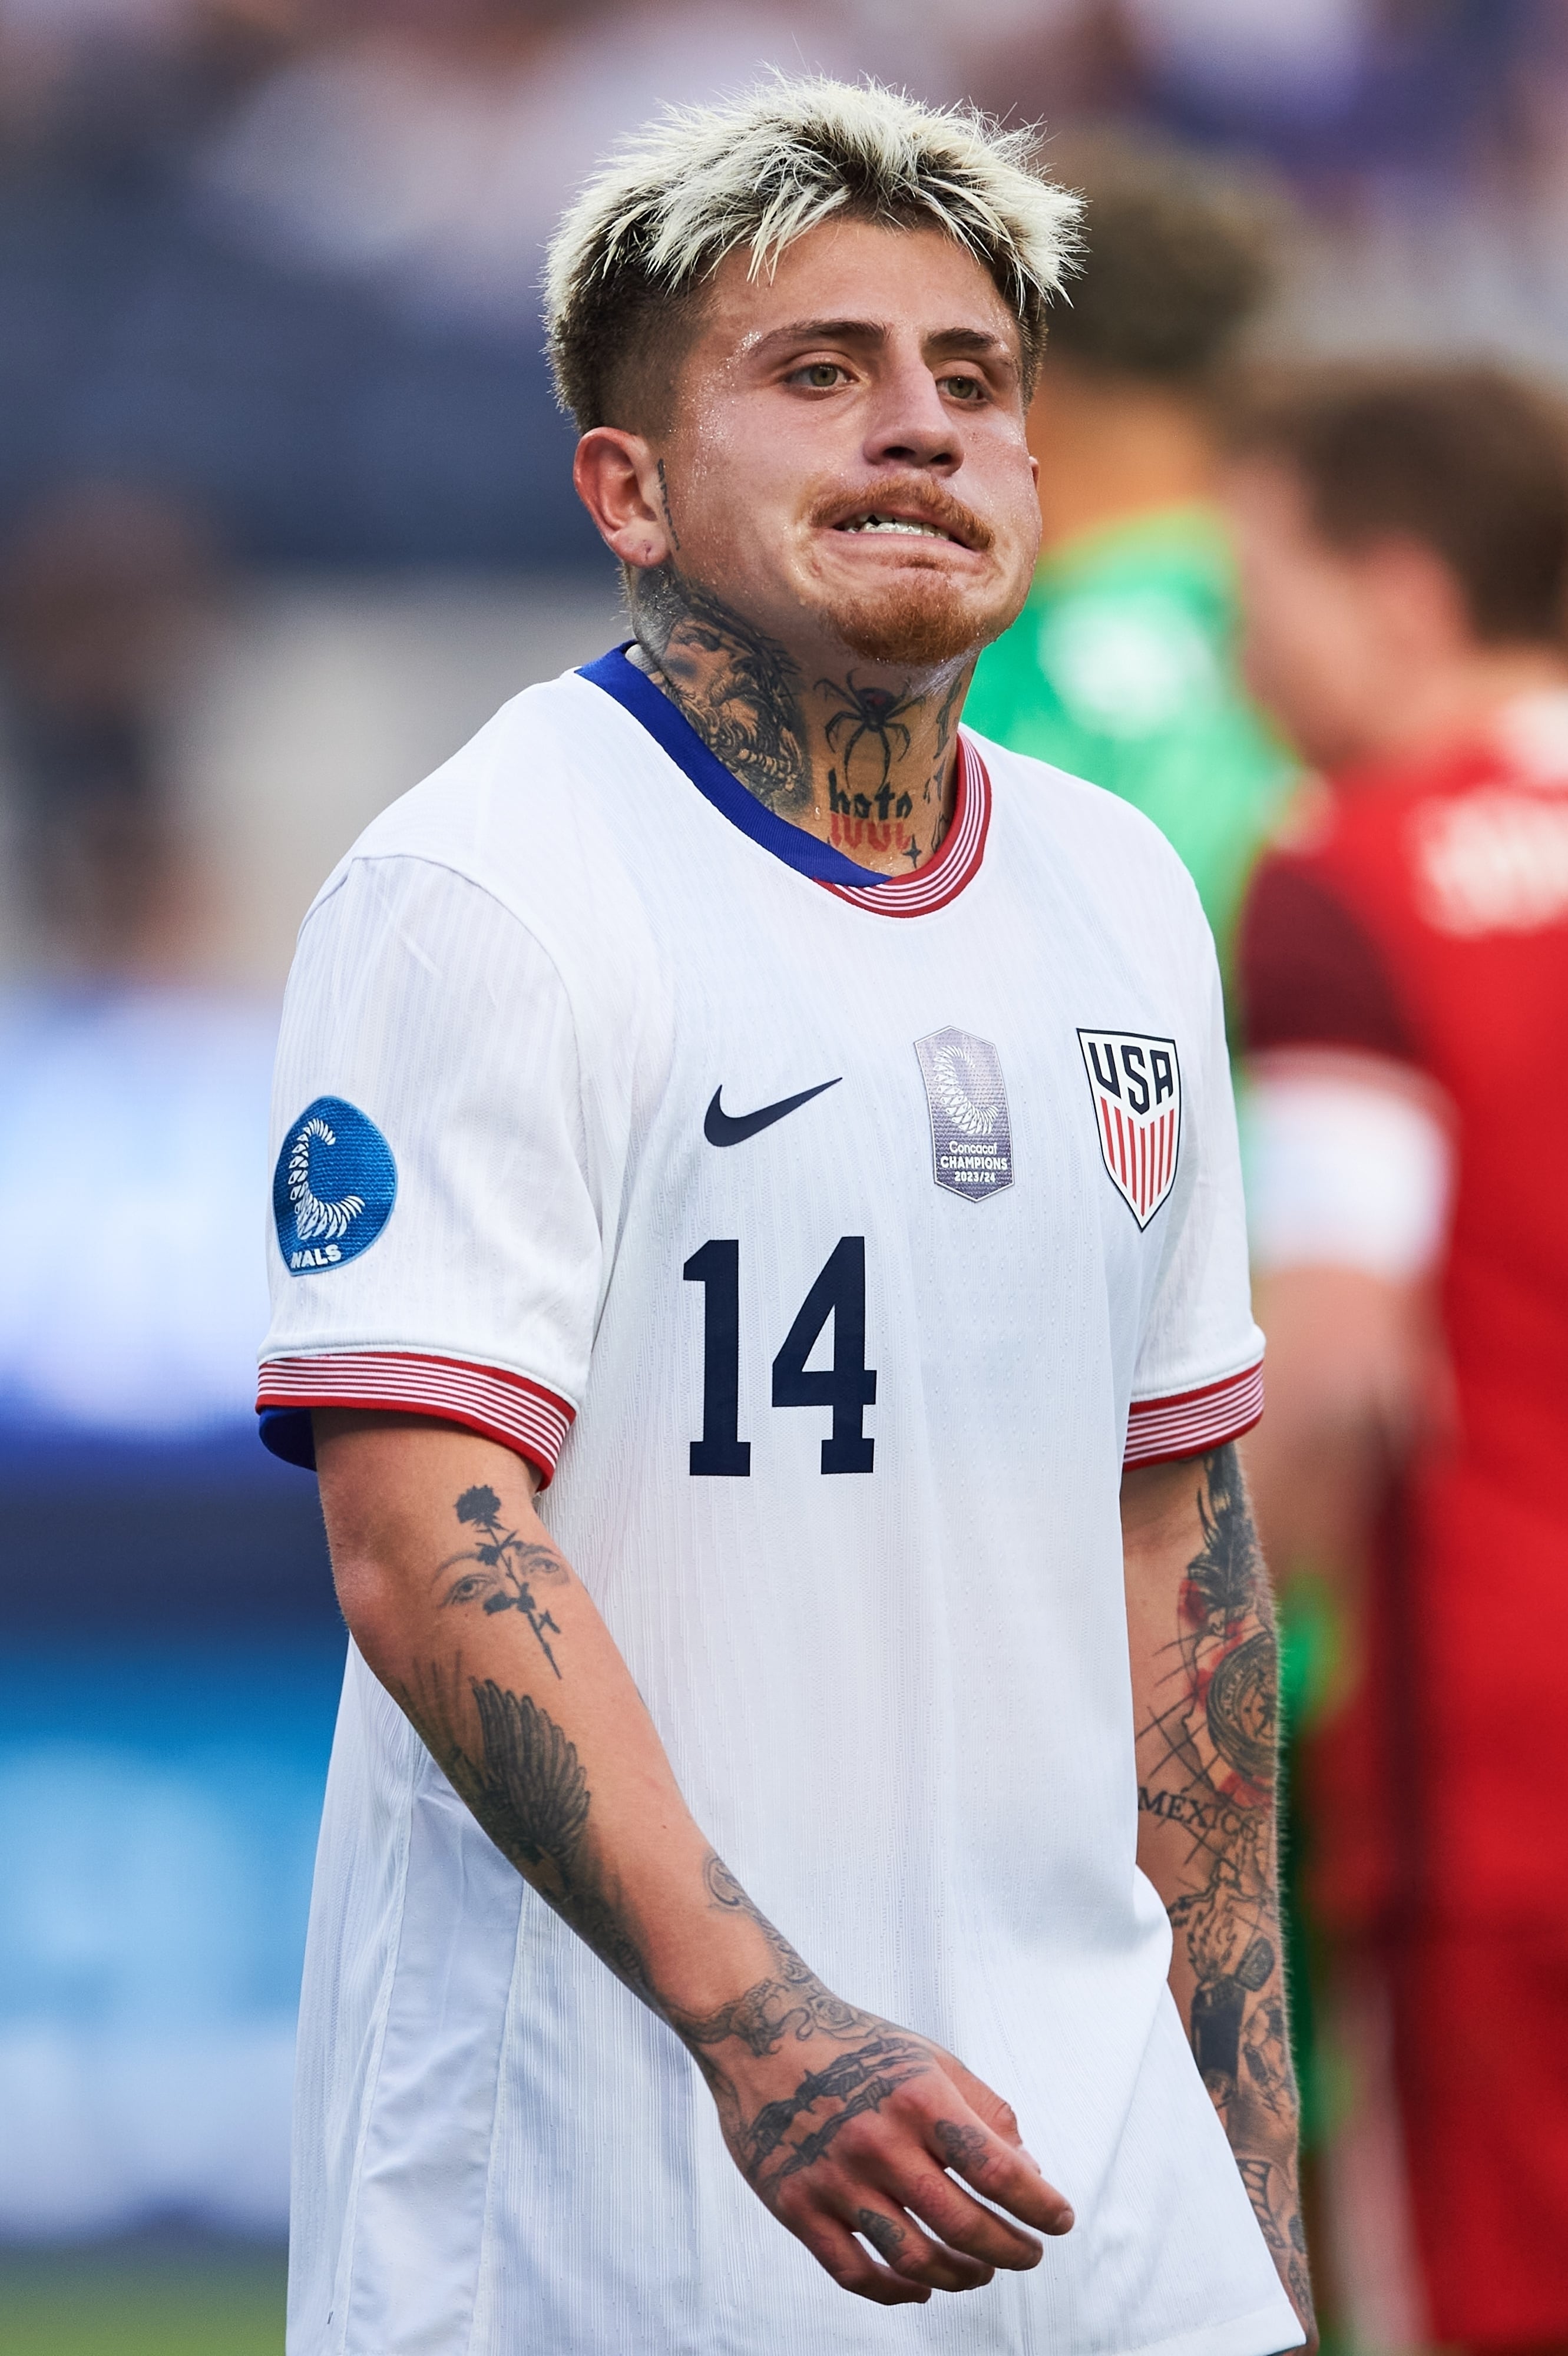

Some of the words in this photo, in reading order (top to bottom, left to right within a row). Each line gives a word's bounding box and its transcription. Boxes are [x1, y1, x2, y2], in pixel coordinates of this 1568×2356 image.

[1088, 1041, 1174, 1116] USA
[949, 1140, 997, 1155] Concacaf
[940, 1156, 1008, 1170] CHAMPIONS
[954, 1171, 996, 1183] 2023/24
[290, 1244, 342, 1269] NALS
[683, 1236, 877, 1477] 14
